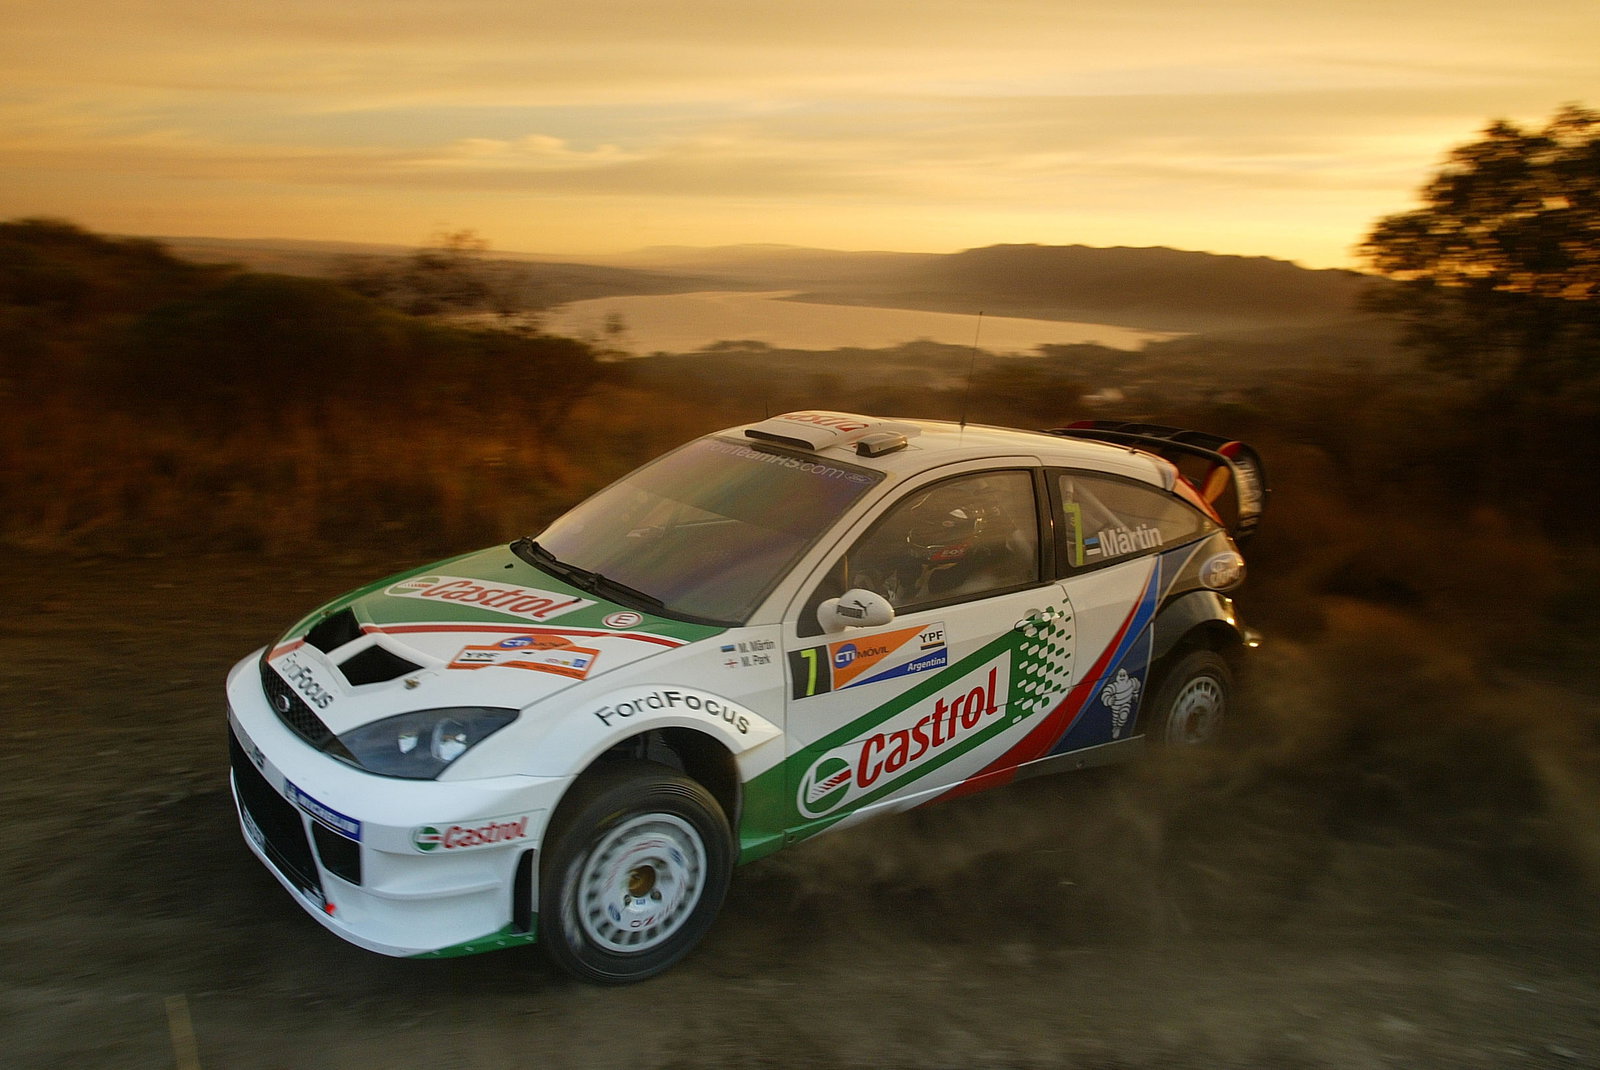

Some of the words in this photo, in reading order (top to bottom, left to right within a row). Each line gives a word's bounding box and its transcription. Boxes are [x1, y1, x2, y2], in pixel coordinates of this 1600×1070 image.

[1098, 523, 1163, 557] Märtin
[421, 580, 582, 618] Castrol
[836, 604, 864, 619] PUMA
[857, 646, 889, 659] MÓVIL
[919, 631, 943, 644] YPF
[752, 653, 771, 666] Park
[801, 649, 817, 696] 7
[907, 656, 946, 672] Argentina
[594, 691, 751, 734] FordFocus
[857, 666, 998, 788] Castrol
[443, 816, 529, 849] Castrol
